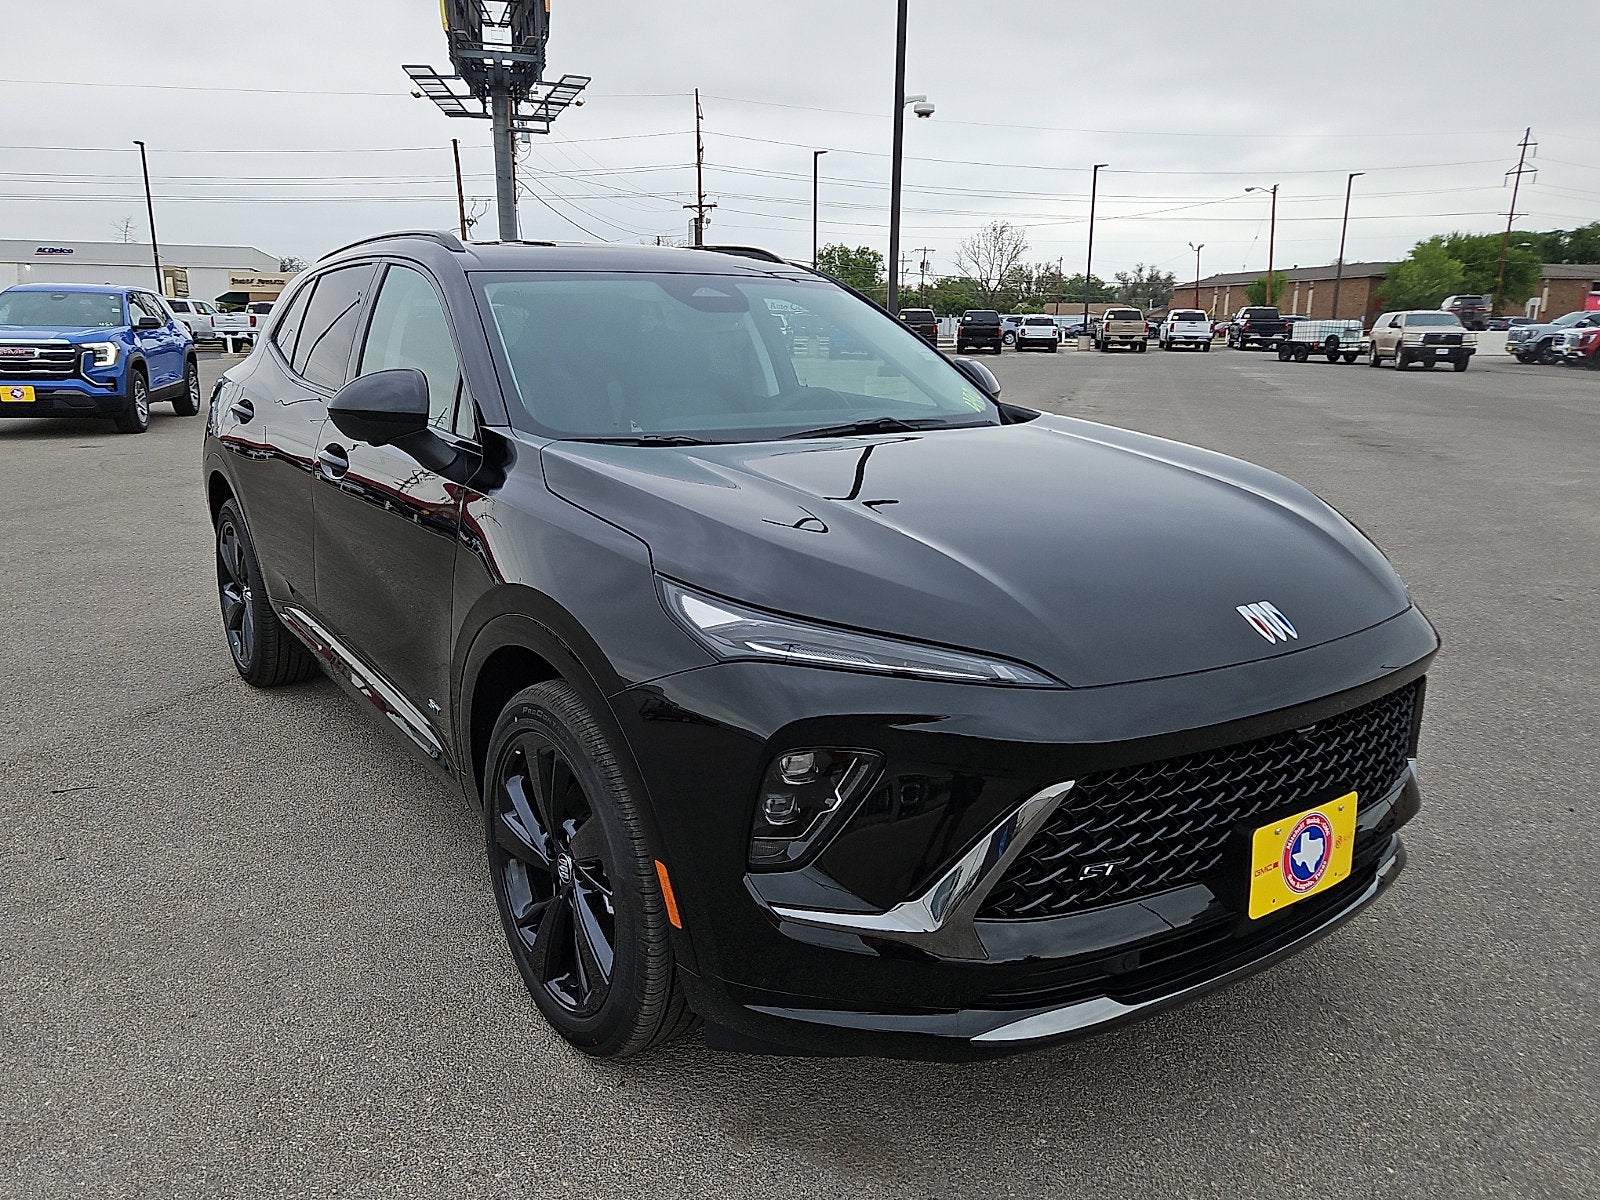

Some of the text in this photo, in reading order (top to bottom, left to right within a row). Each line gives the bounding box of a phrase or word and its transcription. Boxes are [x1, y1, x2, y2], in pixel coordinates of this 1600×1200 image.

[770, 302, 788, 310] Auto
[1286, 822, 1305, 850] Mitchell
[1079, 859, 1125, 881] ST
[1254, 863, 1273, 878] GMC
[1314, 860, 1327, 880] Texas
